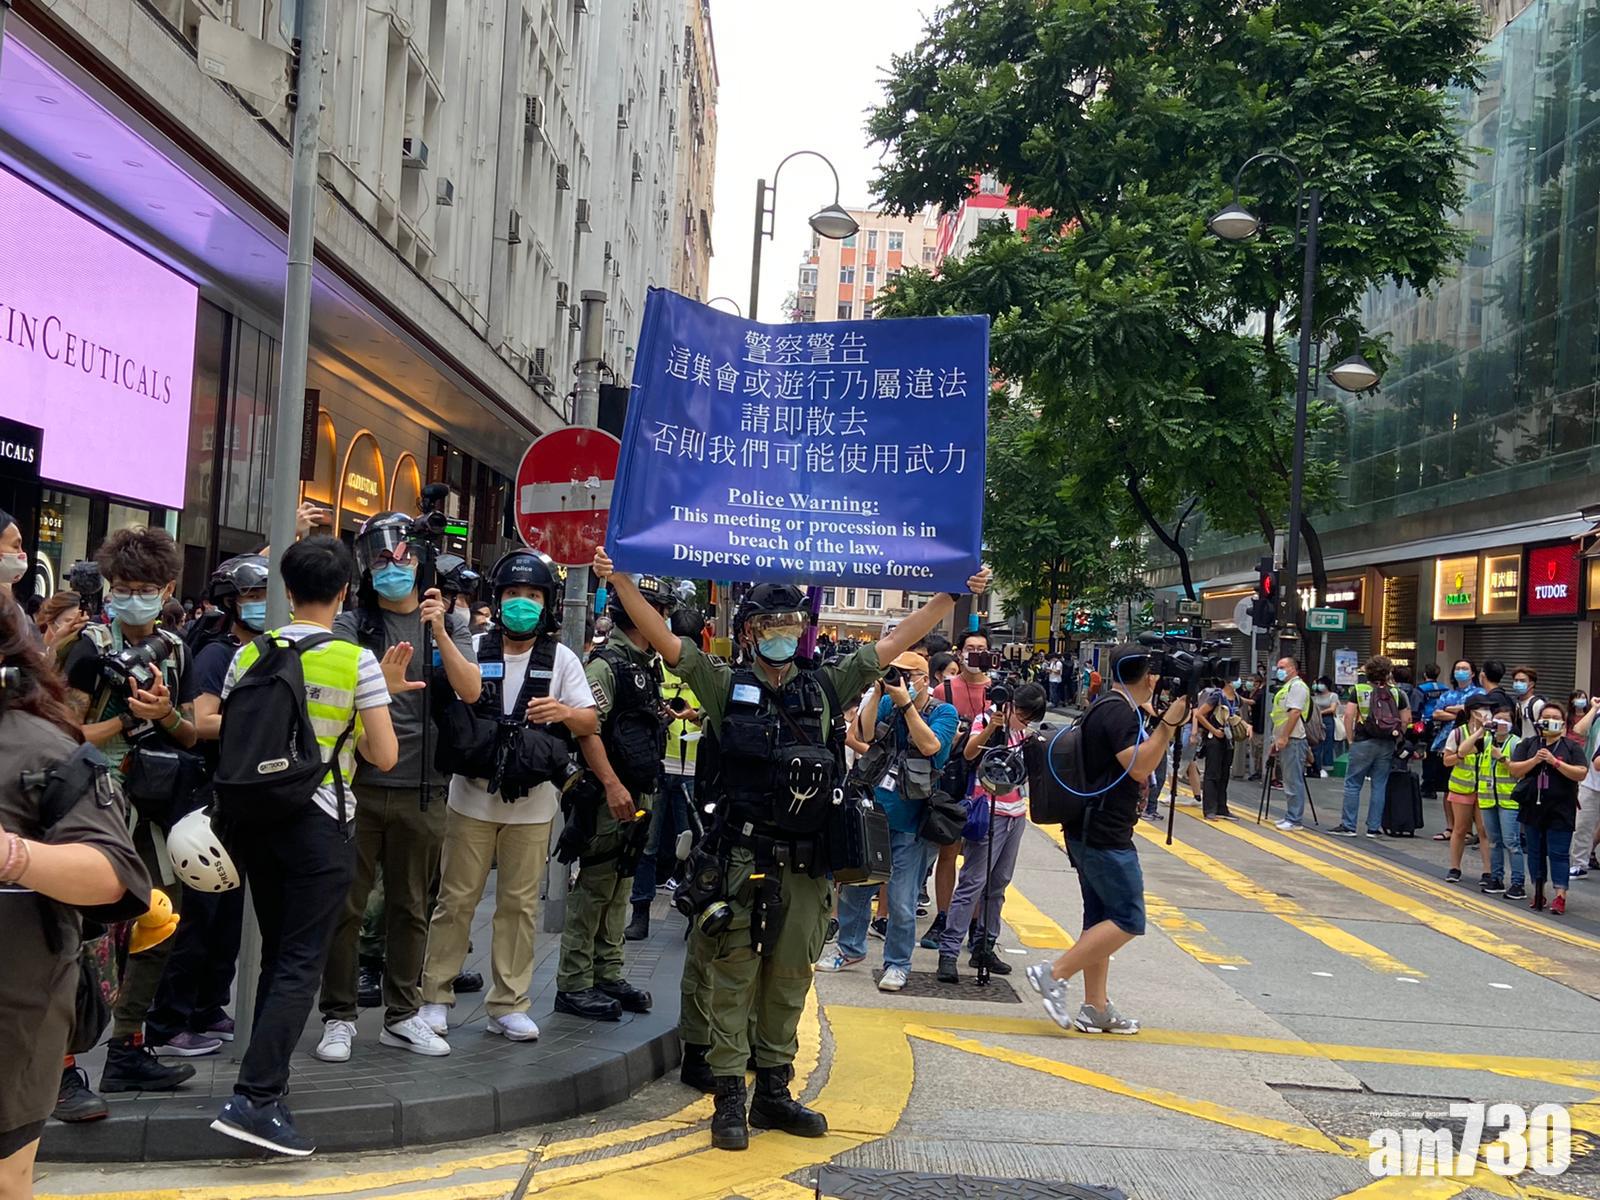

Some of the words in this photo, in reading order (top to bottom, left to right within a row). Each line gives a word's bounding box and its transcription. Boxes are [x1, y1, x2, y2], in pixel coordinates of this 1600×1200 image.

[0, 304, 171, 404] INCEUTICALS
[744, 330, 868, 363] 警察警告
[665, 343, 967, 401] 這集會或遊行乃屬違法
[741, 402, 868, 436] 請即散去
[0, 440, 35, 463] ICALS
[653, 421, 966, 474] 否則我們可能使用武力
[728, 488, 785, 508] Police
[789, 493, 879, 516] Warning:
[671, 505, 708, 523] This
[713, 513, 781, 533] meeting
[786, 519, 805, 531] or
[809, 520, 897, 536] procession
[902, 521, 915, 537] is
[920, 521, 937, 537] in
[728, 531, 789, 550] breach
[794, 537, 813, 552] of
[816, 538, 844, 553] the
[849, 540, 884, 556] law.
[673, 544, 751, 567] Disperse
[755, 555, 775, 568] or
[779, 557, 804, 570] we
[809, 560, 847, 577] may
[853, 560, 881, 575] use
[886, 559, 934, 578] force.
[1535, 584, 1568, 599] TUDOR
